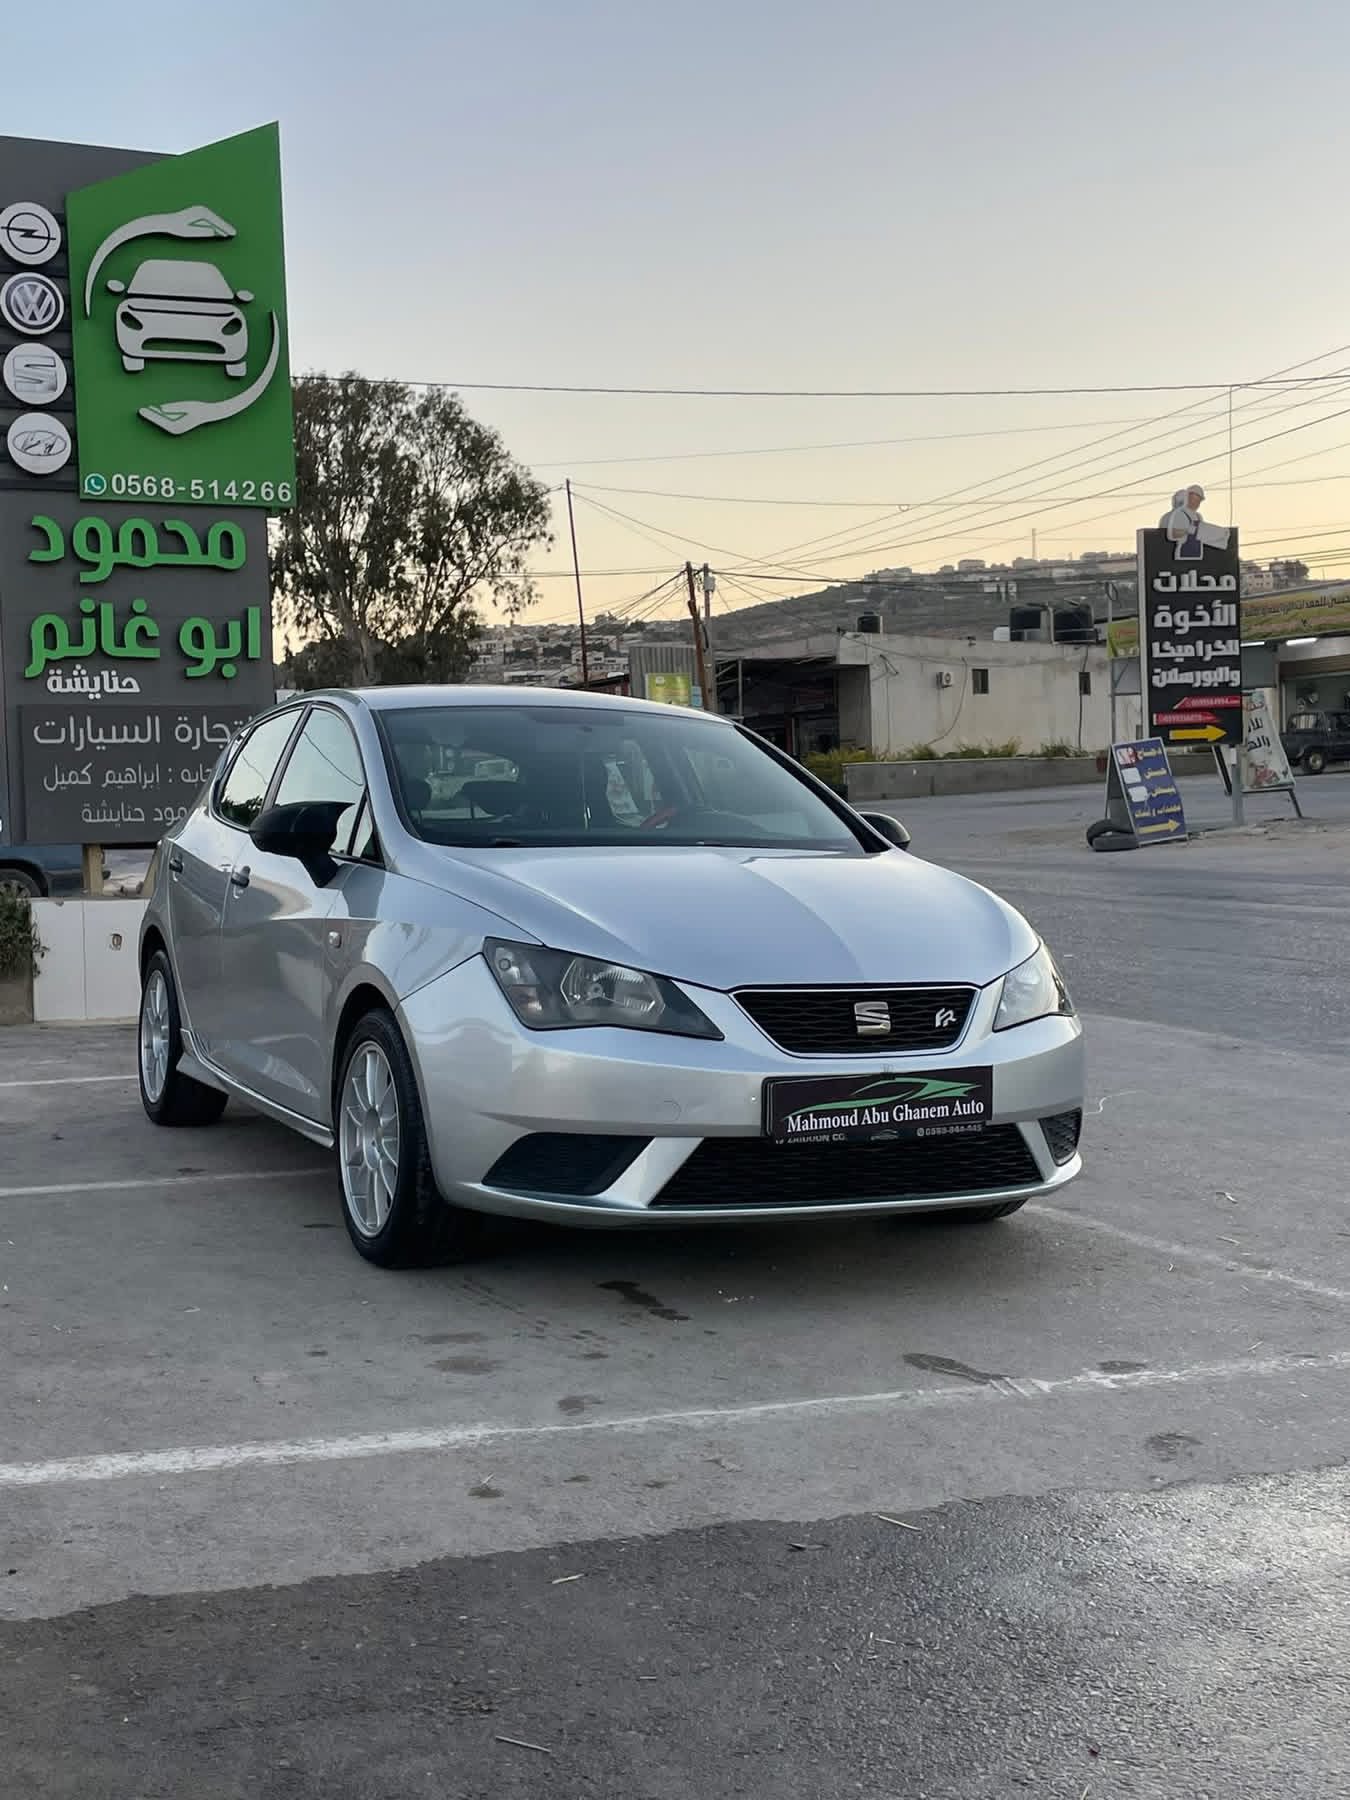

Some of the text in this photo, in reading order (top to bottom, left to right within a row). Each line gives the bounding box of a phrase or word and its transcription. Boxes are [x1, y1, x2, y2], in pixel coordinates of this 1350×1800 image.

[111, 474, 291, 502] 0568-514266
[28, 515, 247, 583] محمود
[1153, 569, 1237, 593] محلات
[1153, 599, 1237, 635] الأخوة
[24, 597, 261, 678] ابو غانم
[46, 664, 140, 699] حنايشة
[33, 715, 161, 751] السيارات
[43, 762, 92, 792] كميل
[102, 763, 160, 790] ابراهيم
[81, 801, 145, 828] حنايشة
[786, 1098, 985, 1133] Mahmoud Abu Ghanem Auto
